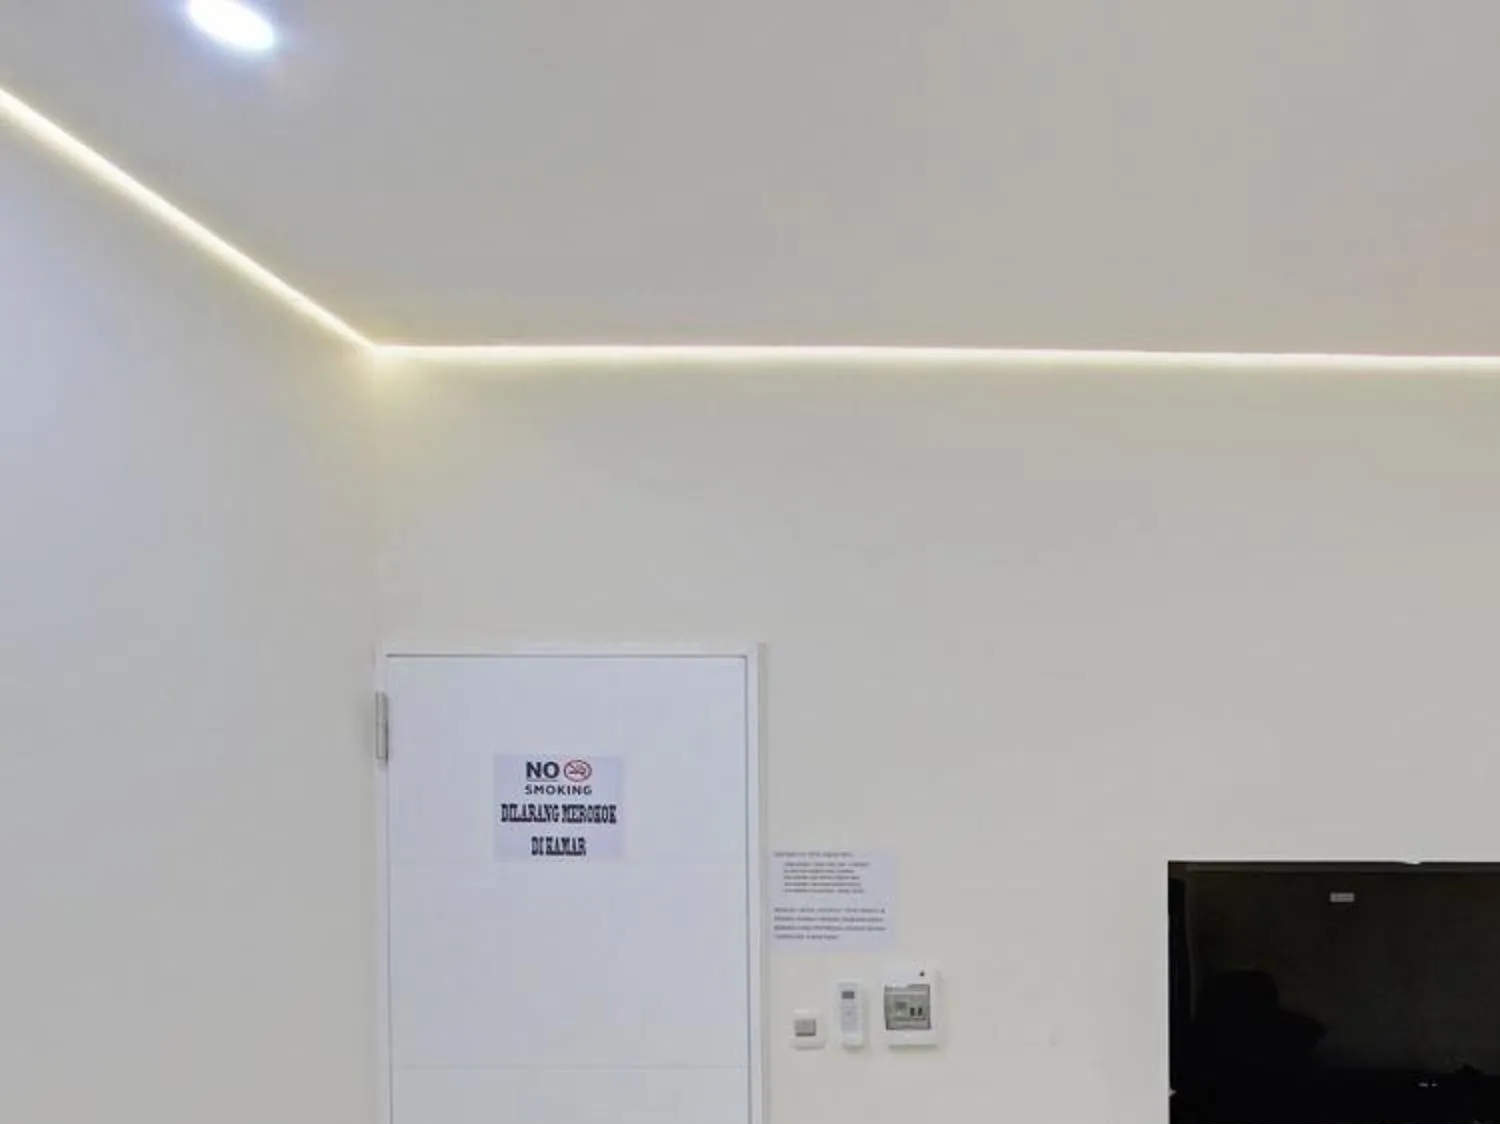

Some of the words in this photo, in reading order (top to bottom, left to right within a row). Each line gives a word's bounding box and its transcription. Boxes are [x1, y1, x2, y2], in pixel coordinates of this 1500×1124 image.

[525, 761, 560, 779] NO
[524, 784, 592, 795] SMOKING
[501, 803, 560, 823] DILARANG
[561, 803, 617, 824] MEROKOK
[531, 836, 544, 856] DI
[545, 836, 587, 856] KAMAR
